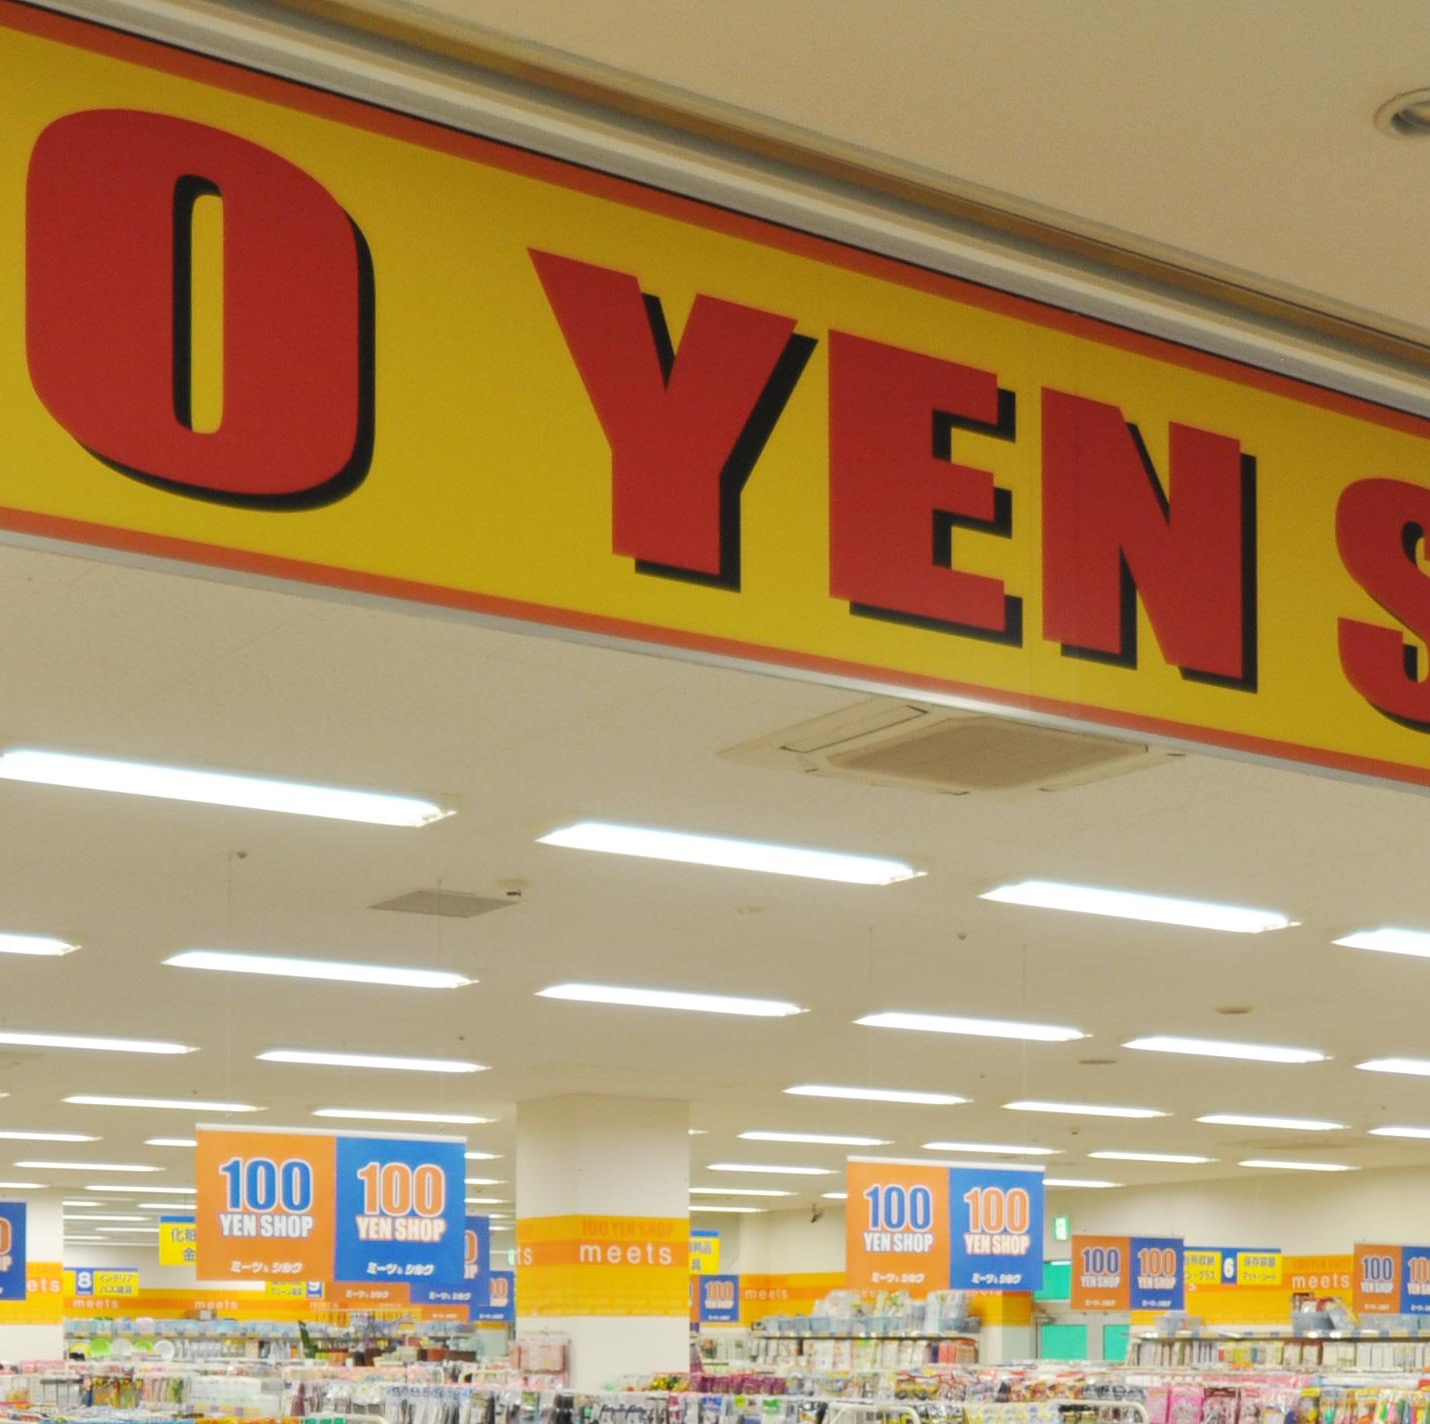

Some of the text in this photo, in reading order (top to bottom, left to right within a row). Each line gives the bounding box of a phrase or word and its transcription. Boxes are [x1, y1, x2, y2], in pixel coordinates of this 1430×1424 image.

[526, 247, 1259, 693] YEN
[219, 1156, 313, 1214] 100
[357, 1161, 446, 1218] 100
[863, 1184, 934, 1233] 100
[964, 1187, 1030, 1235] 100
[219, 1213, 314, 1239] YEN SHOP
[356, 1216, 446, 1243] YEN SHOP
[579, 1243, 672, 1265] meets
[863, 1232, 934, 1253] YEN SHOP
[964, 1233, 1031, 1255] YEN SHOP
[1082, 1247, 1120, 1276] 100
[1137, 1247, 1177, 1277] 100
[1223, 1257, 1235, 1279] 6
[1361, 1257, 1394, 1281] 100
[27, 1277, 61, 1292] ets
[77, 1271, 92, 1289] 8
[1292, 1274, 1350, 1289] meets
